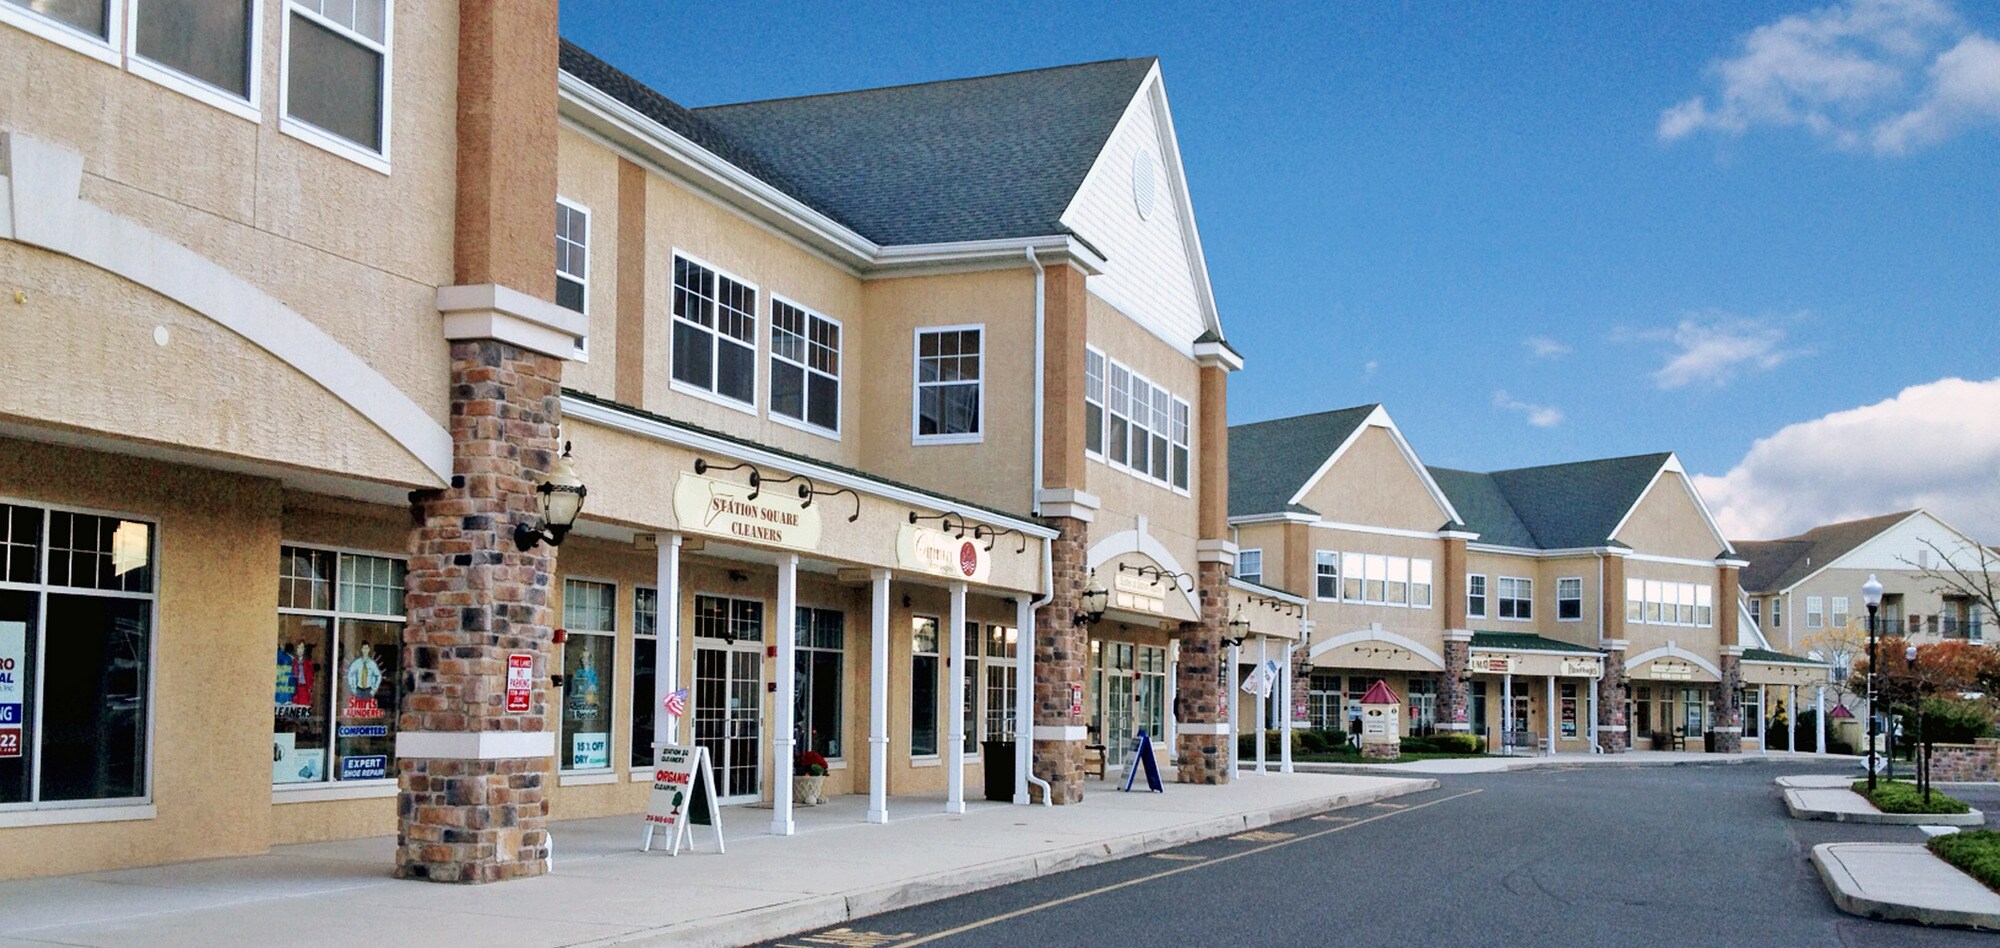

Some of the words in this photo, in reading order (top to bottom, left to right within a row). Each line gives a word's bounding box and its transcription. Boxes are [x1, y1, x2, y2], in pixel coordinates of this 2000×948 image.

[712, 497, 759, 518] STATION
[760, 509, 799, 526] SQUARE
[731, 521, 782, 541] CLEANERS
[510, 678, 530, 688] PARKING
[348, 695, 378, 709] Shirts
[340, 726, 387, 736] COMFORTERS
[592, 741, 605, 751] OFF
[348, 759, 381, 769] EXPERT
[574, 755, 588, 764] DRY
[344, 770, 361, 778] SHOE
[361, 769, 385, 778] REPAIR
[656, 770, 690, 785] ORGANIC
